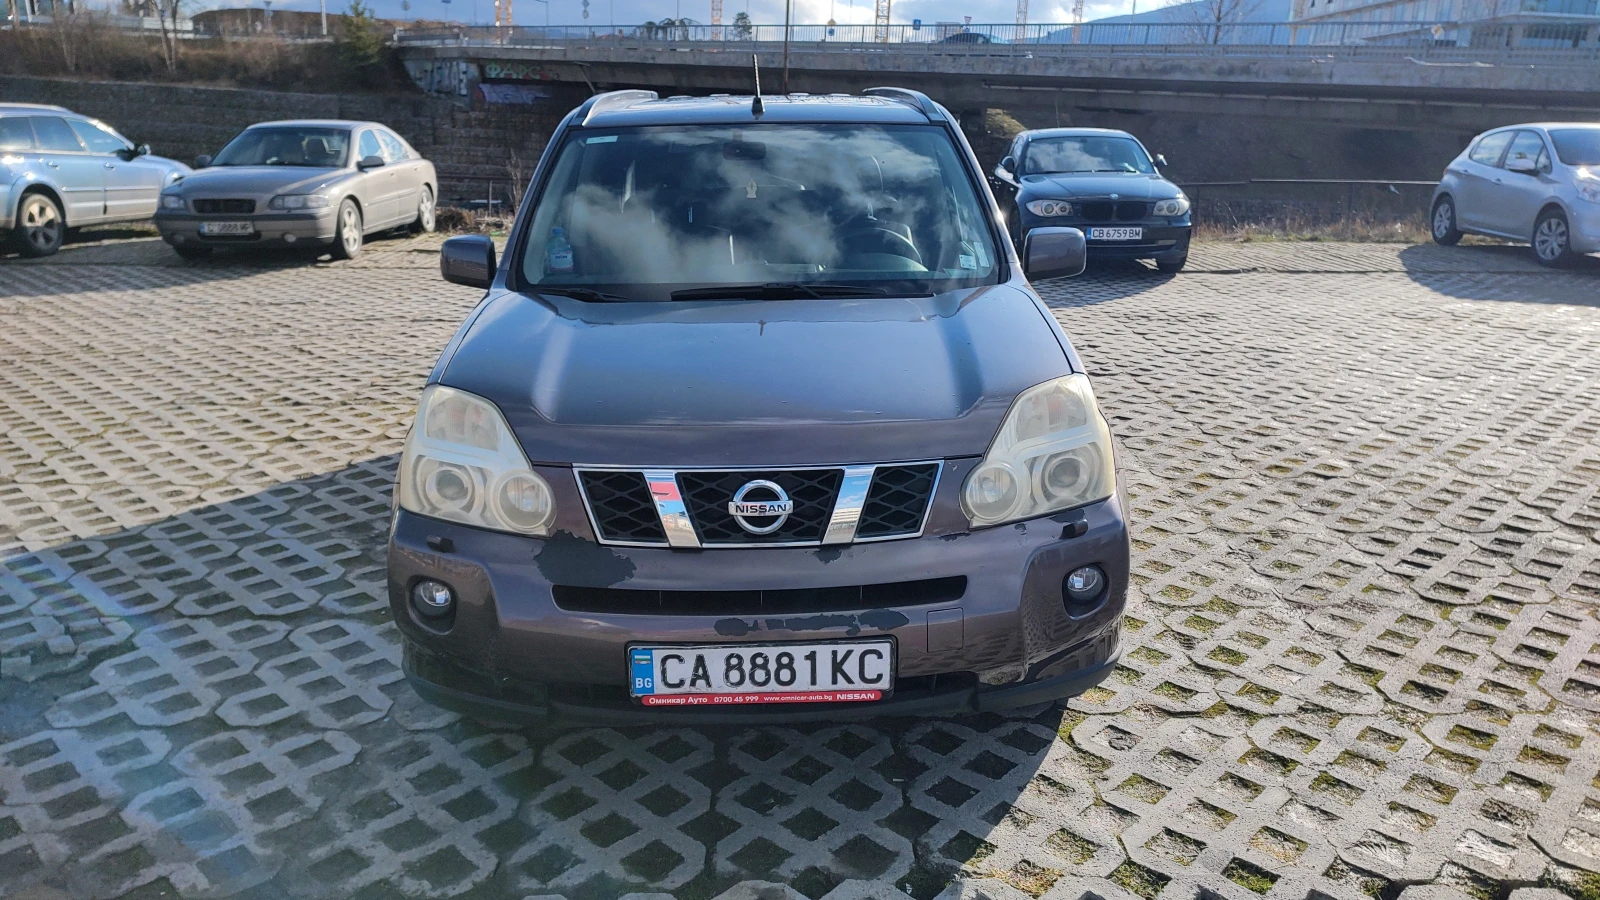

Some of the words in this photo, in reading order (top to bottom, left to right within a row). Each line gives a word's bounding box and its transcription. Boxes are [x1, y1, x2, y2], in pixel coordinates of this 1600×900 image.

[1092, 229, 1105, 238] CB
[1106, 229, 1128, 238] 6759
[735, 504, 787, 514] NISSAN
[660, 653, 712, 689] CA
[723, 650, 818, 688] 8881
[831, 648, 884, 686] KC
[635, 677, 653, 689] BG
[649, 697, 686, 705] Омникар
[687, 696, 708, 704] Ауто
[836, 692, 875, 700] NISSAN
